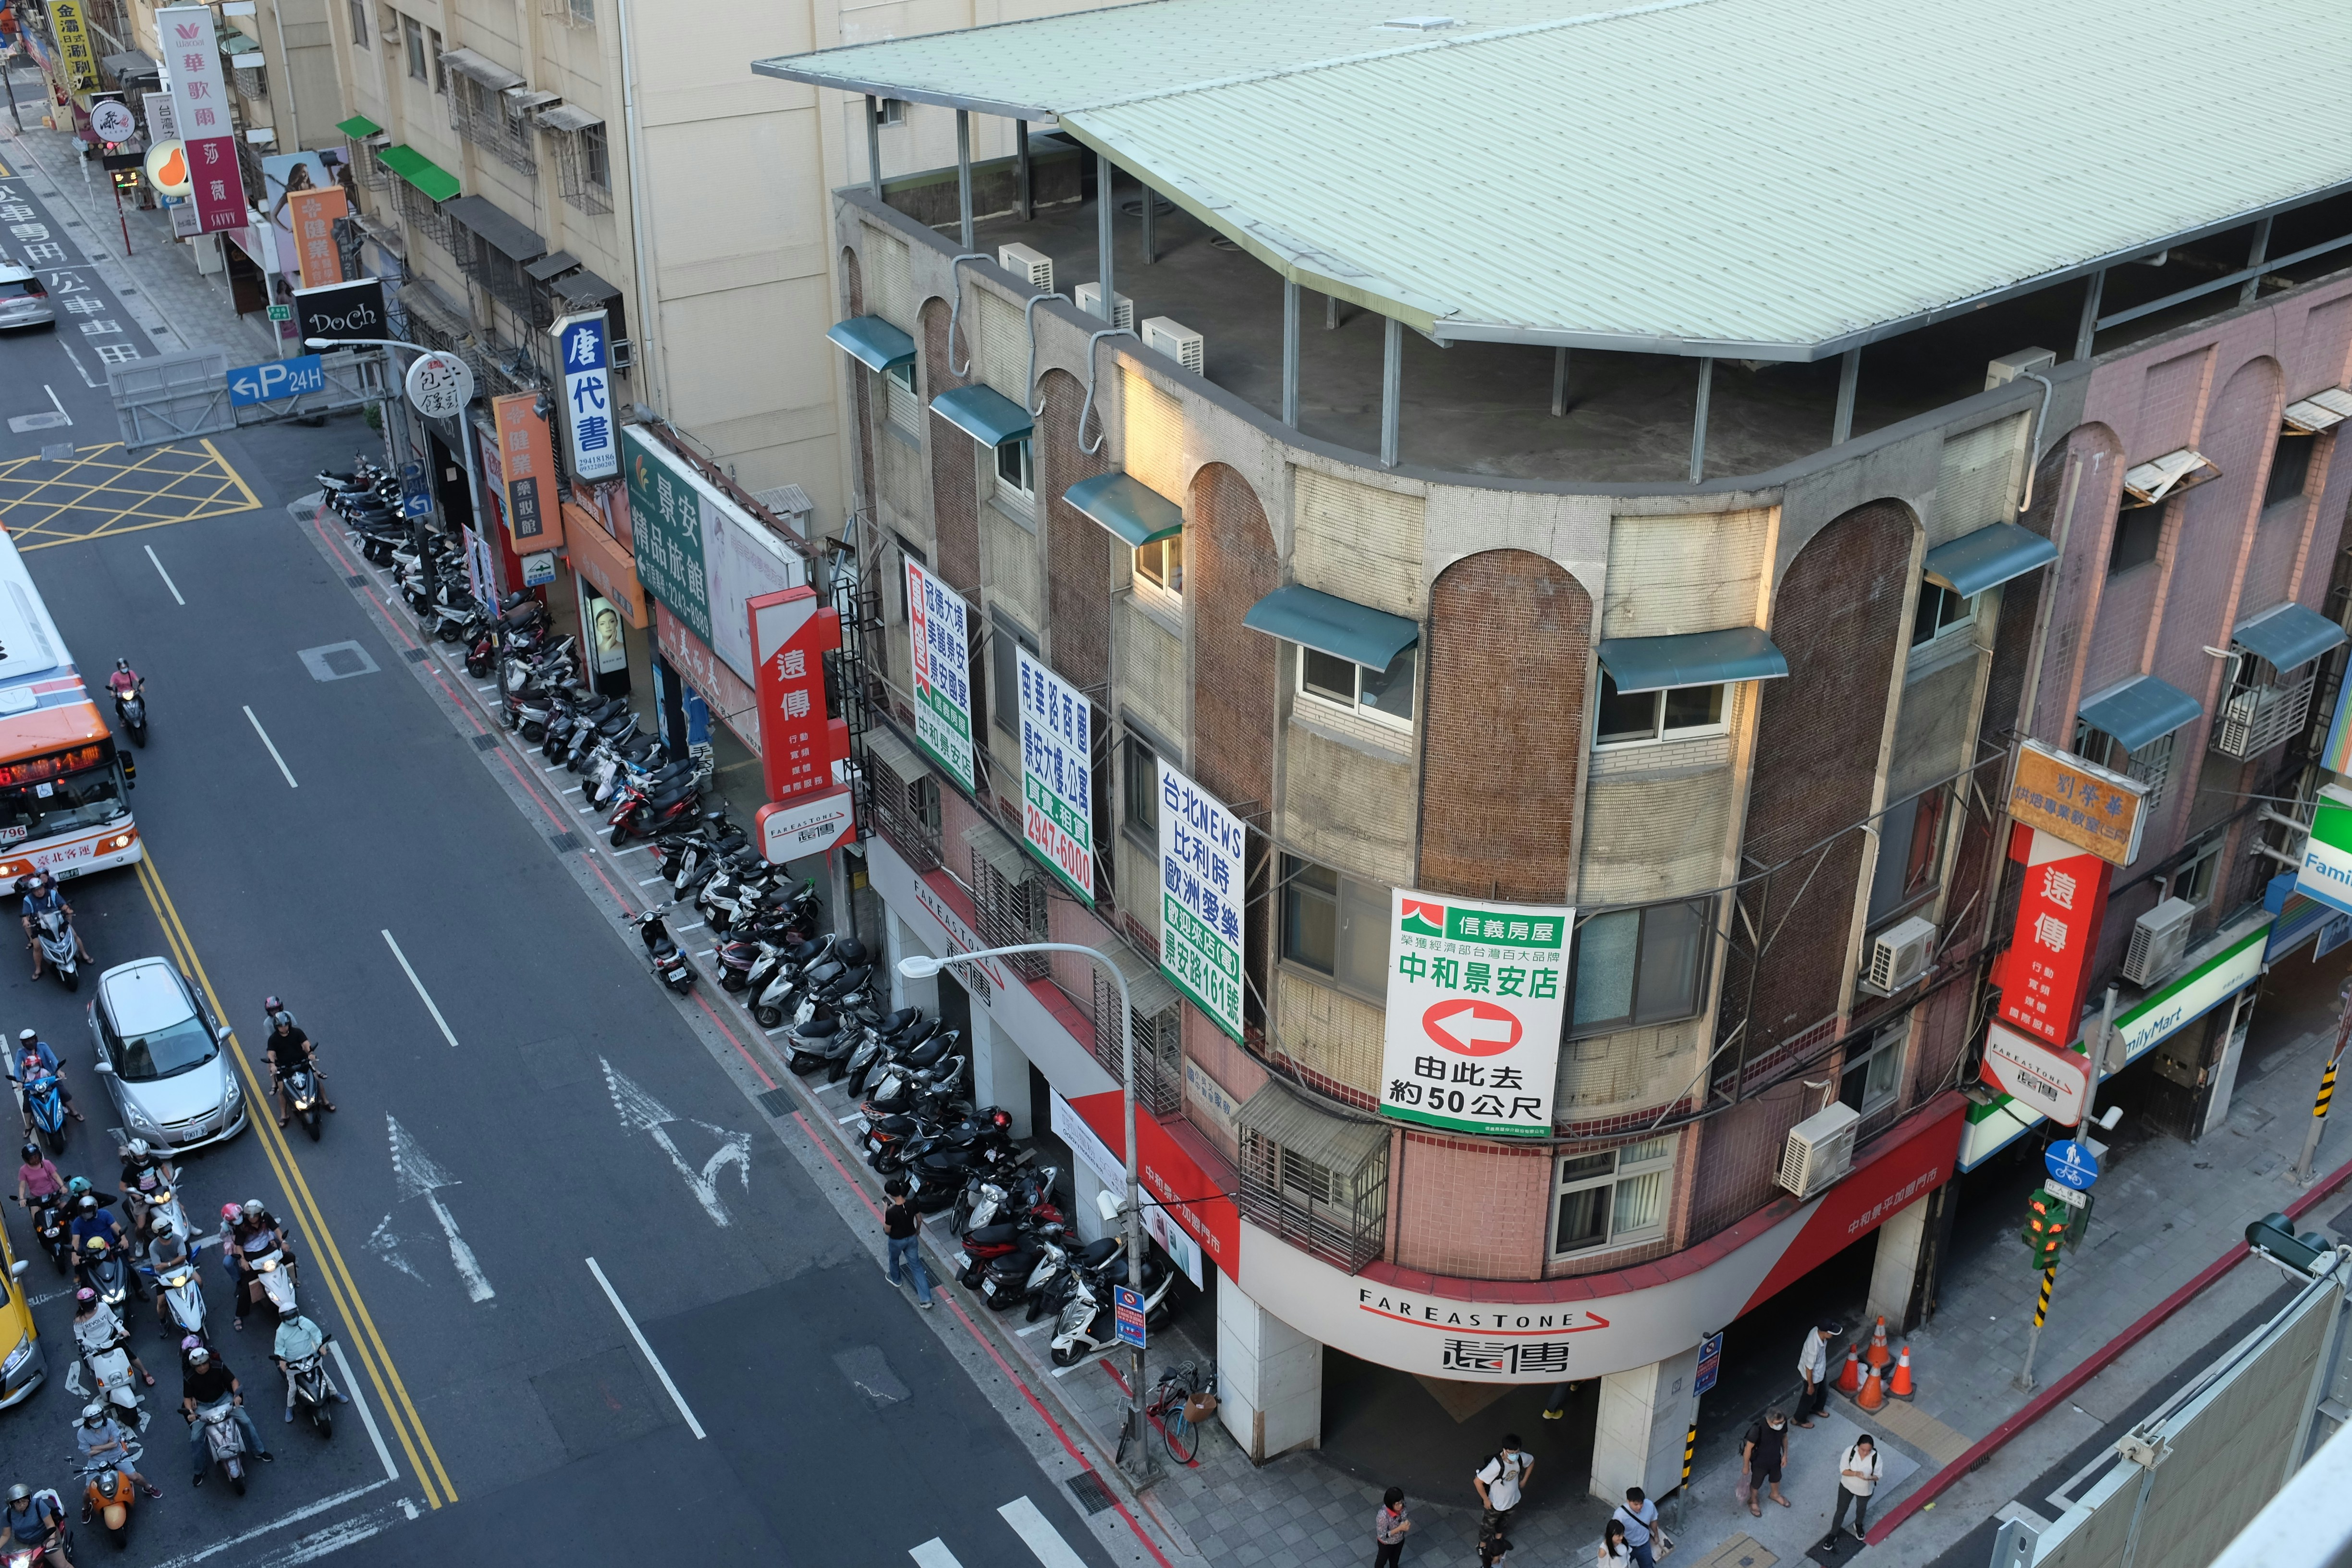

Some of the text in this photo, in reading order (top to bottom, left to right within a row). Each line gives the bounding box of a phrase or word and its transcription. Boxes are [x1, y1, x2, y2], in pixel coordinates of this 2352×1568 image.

[176, 39, 205, 48] Wacoal
[183, 53, 216, 127] 華歌爾
[203, 142, 226, 201] 莎薇
[211, 211, 235, 227] SAVVY
[304, 219, 330, 258] 健業
[309, 303, 376, 332] DoCh
[259, 364, 322, 398] P 24H
[569, 328, 609, 452] 唐代書
[508, 429, 532, 476] 健業
[579, 453, 614, 466] 29418186
[579, 461, 615, 472] 0932200203
[517, 481, 537, 535] 藥妝館
[657, 473, 698, 547] 景安
[631, 505, 705, 605] 精品旅館
[925, 578, 964, 637] 冠德大境
[680, 628, 720, 696] 美而美
[928, 615, 966, 674] 美麗景安
[777, 649, 810, 721] 遠傳
[930, 653, 968, 712] 景安國宴
[934, 693, 966, 735] 信義房屋
[1021, 660, 1087, 755] 南華路商圈
[789, 732, 808, 744] 行動
[790, 747, 809, 760] 寬頻
[918, 715, 972, 781] 中和景安店
[783, 776, 823, 794] 國際服務
[792, 763, 811, 775] 媒體
[0, 827, 25, 839] 796
[798, 822, 834, 843] 遠傳
[1163, 772, 1241, 859] 台北NEWS
[1027, 804, 1090, 890] 2947-6000
[1174, 820, 1230, 895] 比利時
[1165, 855, 1239, 947] 歐洲愛樂
[2034, 866, 2076, 953] 遠傳
[914, 880, 990, 968] FAREASTOE
[1167, 898, 1237, 977] 歡迎來店(電)
[1459, 916, 1554, 942] 信義房屋
[1400, 934, 1560, 963] 榮獲經濟部台灣百大品牌
[2032, 961, 2054, 979] 行動
[1164, 929, 1239, 1026] 景安路161號
[1399, 951, 1558, 1000] 中和景安店
[2028, 978, 2050, 997] 寬頻
[2009, 1006, 2055, 1037] 國際服務
[2024, 995, 2046, 1014] 媒體
[2126, 1006, 2182, 1054] milyMart
[1414, 1055, 1523, 1090] 由此去
[2017, 1069, 2058, 1102] 遠傳
[1389, 1078, 1543, 1121] 約50公尺
[1063, 1128, 1080, 1149] Galaxy
[1848, 1166, 1938, 1234] 中和景平加盟門市
[1443, 1338, 1569, 1374] 遠傳
